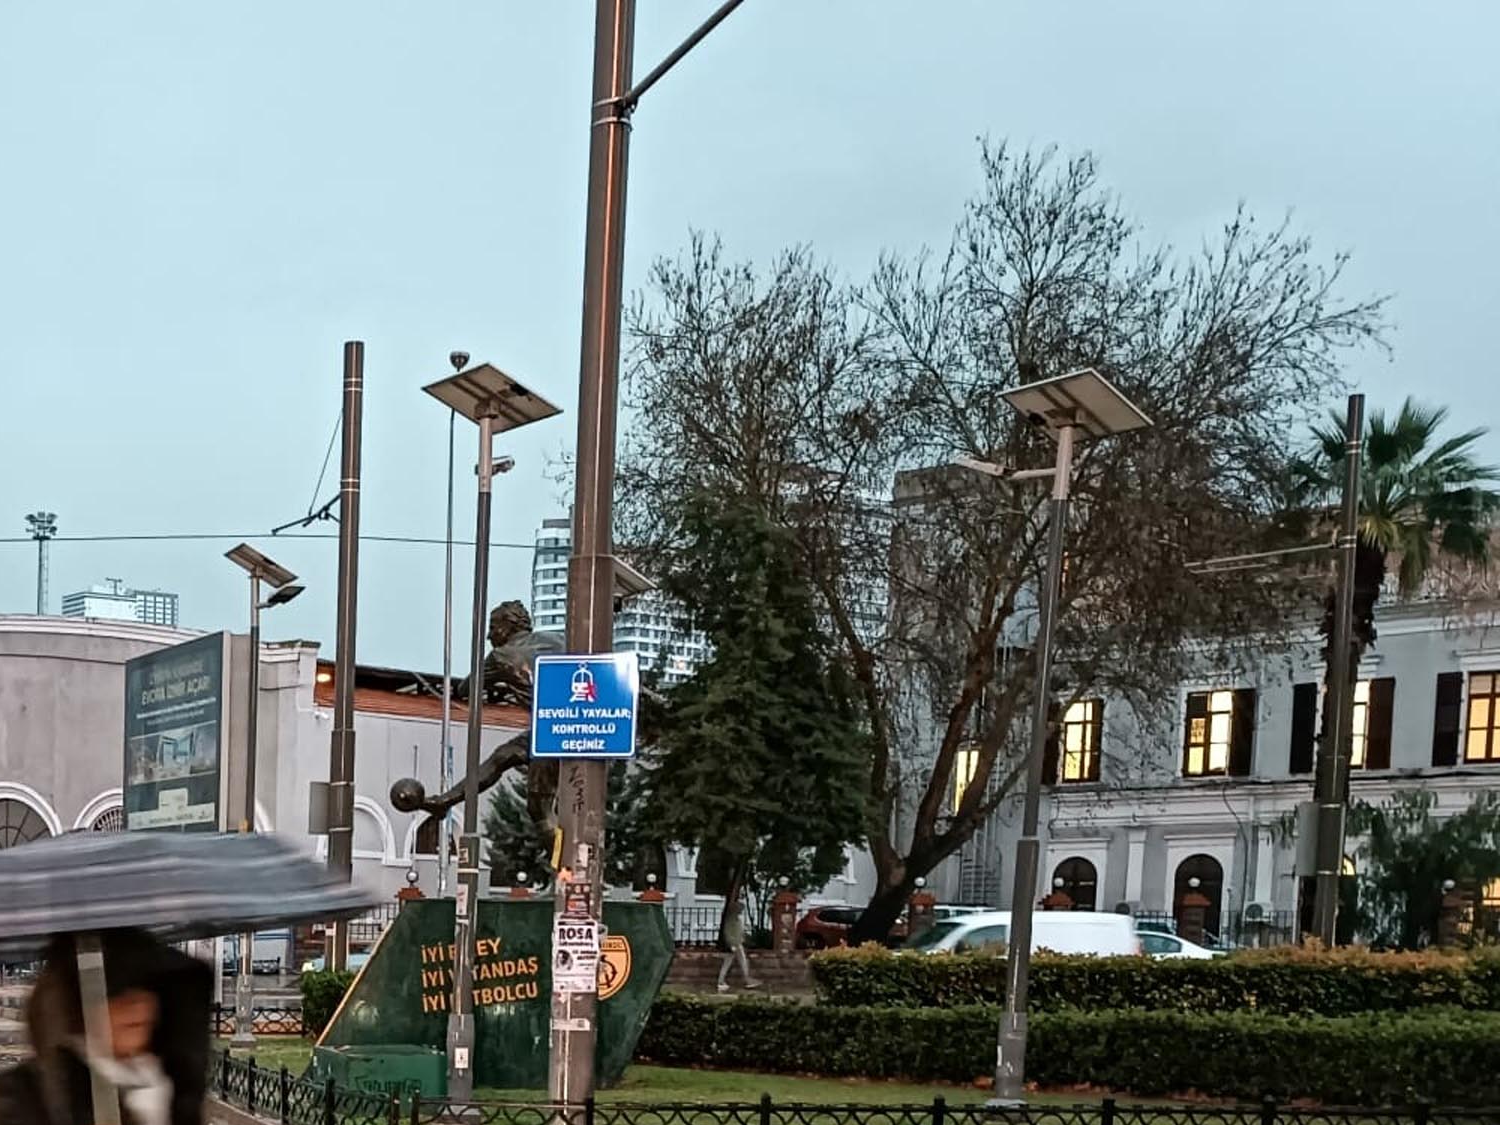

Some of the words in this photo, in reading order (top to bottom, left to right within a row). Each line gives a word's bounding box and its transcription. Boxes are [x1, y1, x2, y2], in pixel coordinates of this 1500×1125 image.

[538, 707, 580, 719] SEVGİLİ
[551, 722, 617, 735] KONTROLLÜ
[561, 738, 606, 752] GEÇİNİZ
[558, 927, 594, 941] ROSA
[421, 941, 445, 965] İYİ
[421, 966, 445, 989] İYİ
[422, 990, 447, 1014] İYİ
